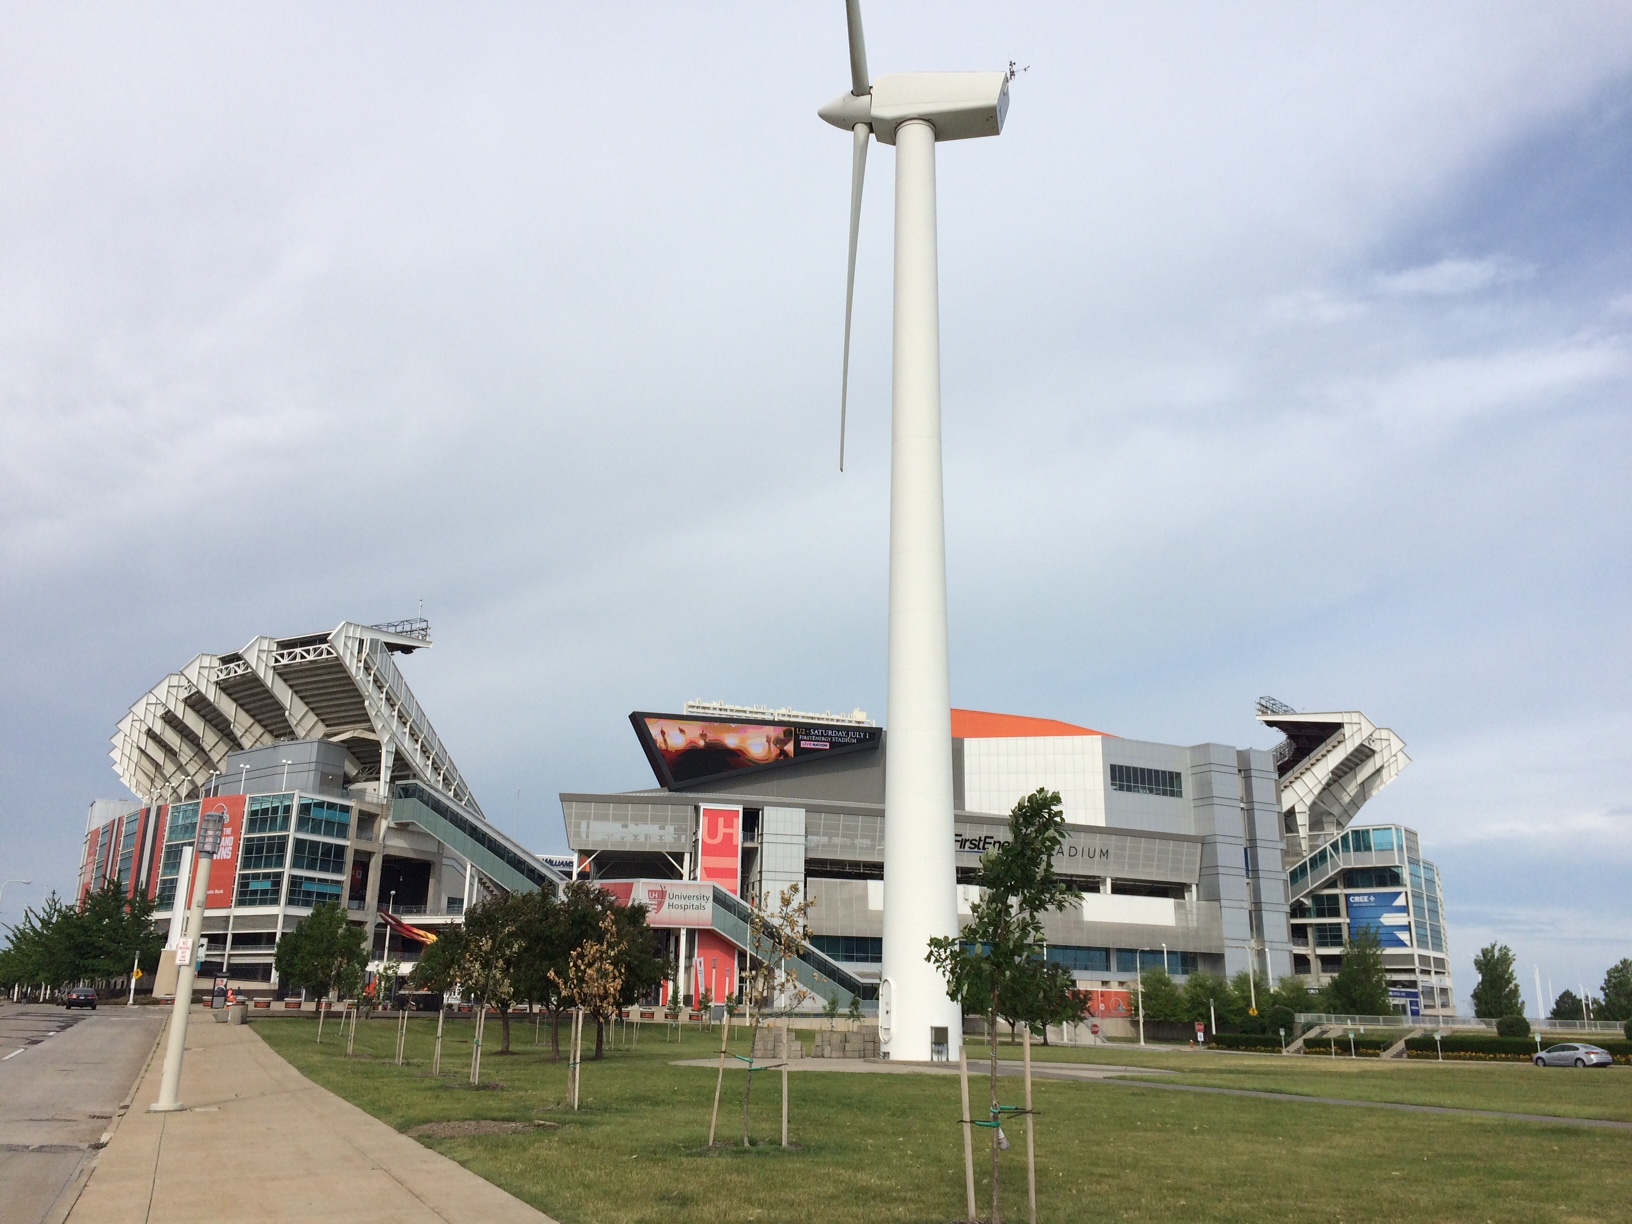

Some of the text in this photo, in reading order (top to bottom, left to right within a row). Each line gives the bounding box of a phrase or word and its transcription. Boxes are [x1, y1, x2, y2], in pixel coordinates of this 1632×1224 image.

[810, 729, 848, 738] SATURDAY,
[848, 731, 865, 740] JULY
[223, 827, 233, 835] THE
[703, 816, 739, 845] UH
[648, 891, 711, 903] UH University
[667, 902, 706, 911] Hospitals
